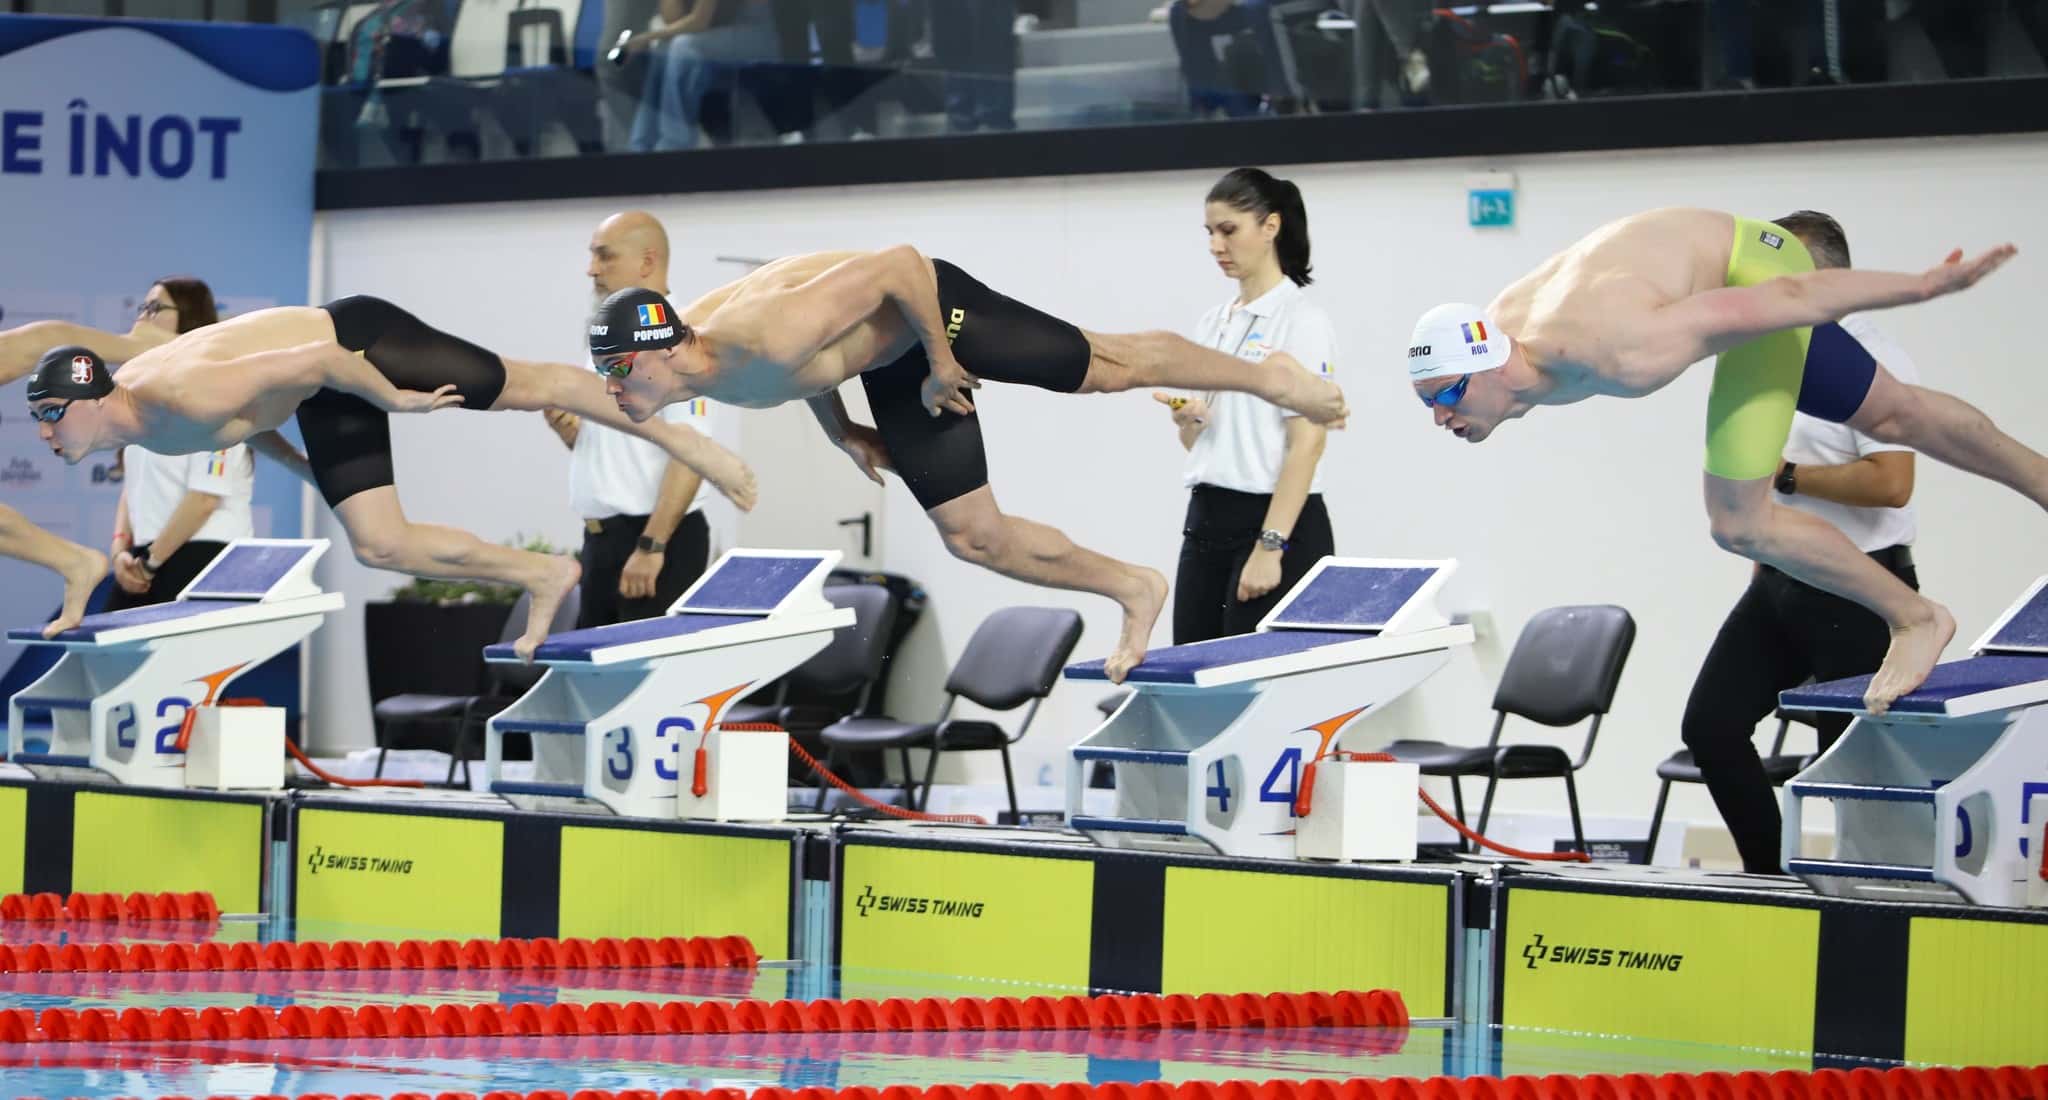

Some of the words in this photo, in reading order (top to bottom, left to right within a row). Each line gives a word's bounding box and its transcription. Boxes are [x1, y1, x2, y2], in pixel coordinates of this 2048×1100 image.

[67, 97, 242, 181] ÎNOT
[1471, 344, 1489, 356] ROU
[155, 696, 193, 754] 2
[654, 716, 696, 781] 3
[1259, 747, 1303, 818] 4
[326, 854, 369, 872] SWISS
[370, 857, 414, 875] TIMING
[878, 896, 929, 914] SWISS
[931, 899, 985, 918] TIMING
[1549, 945, 1613, 967] SWISS
[1616, 950, 1684, 972] TIMING
